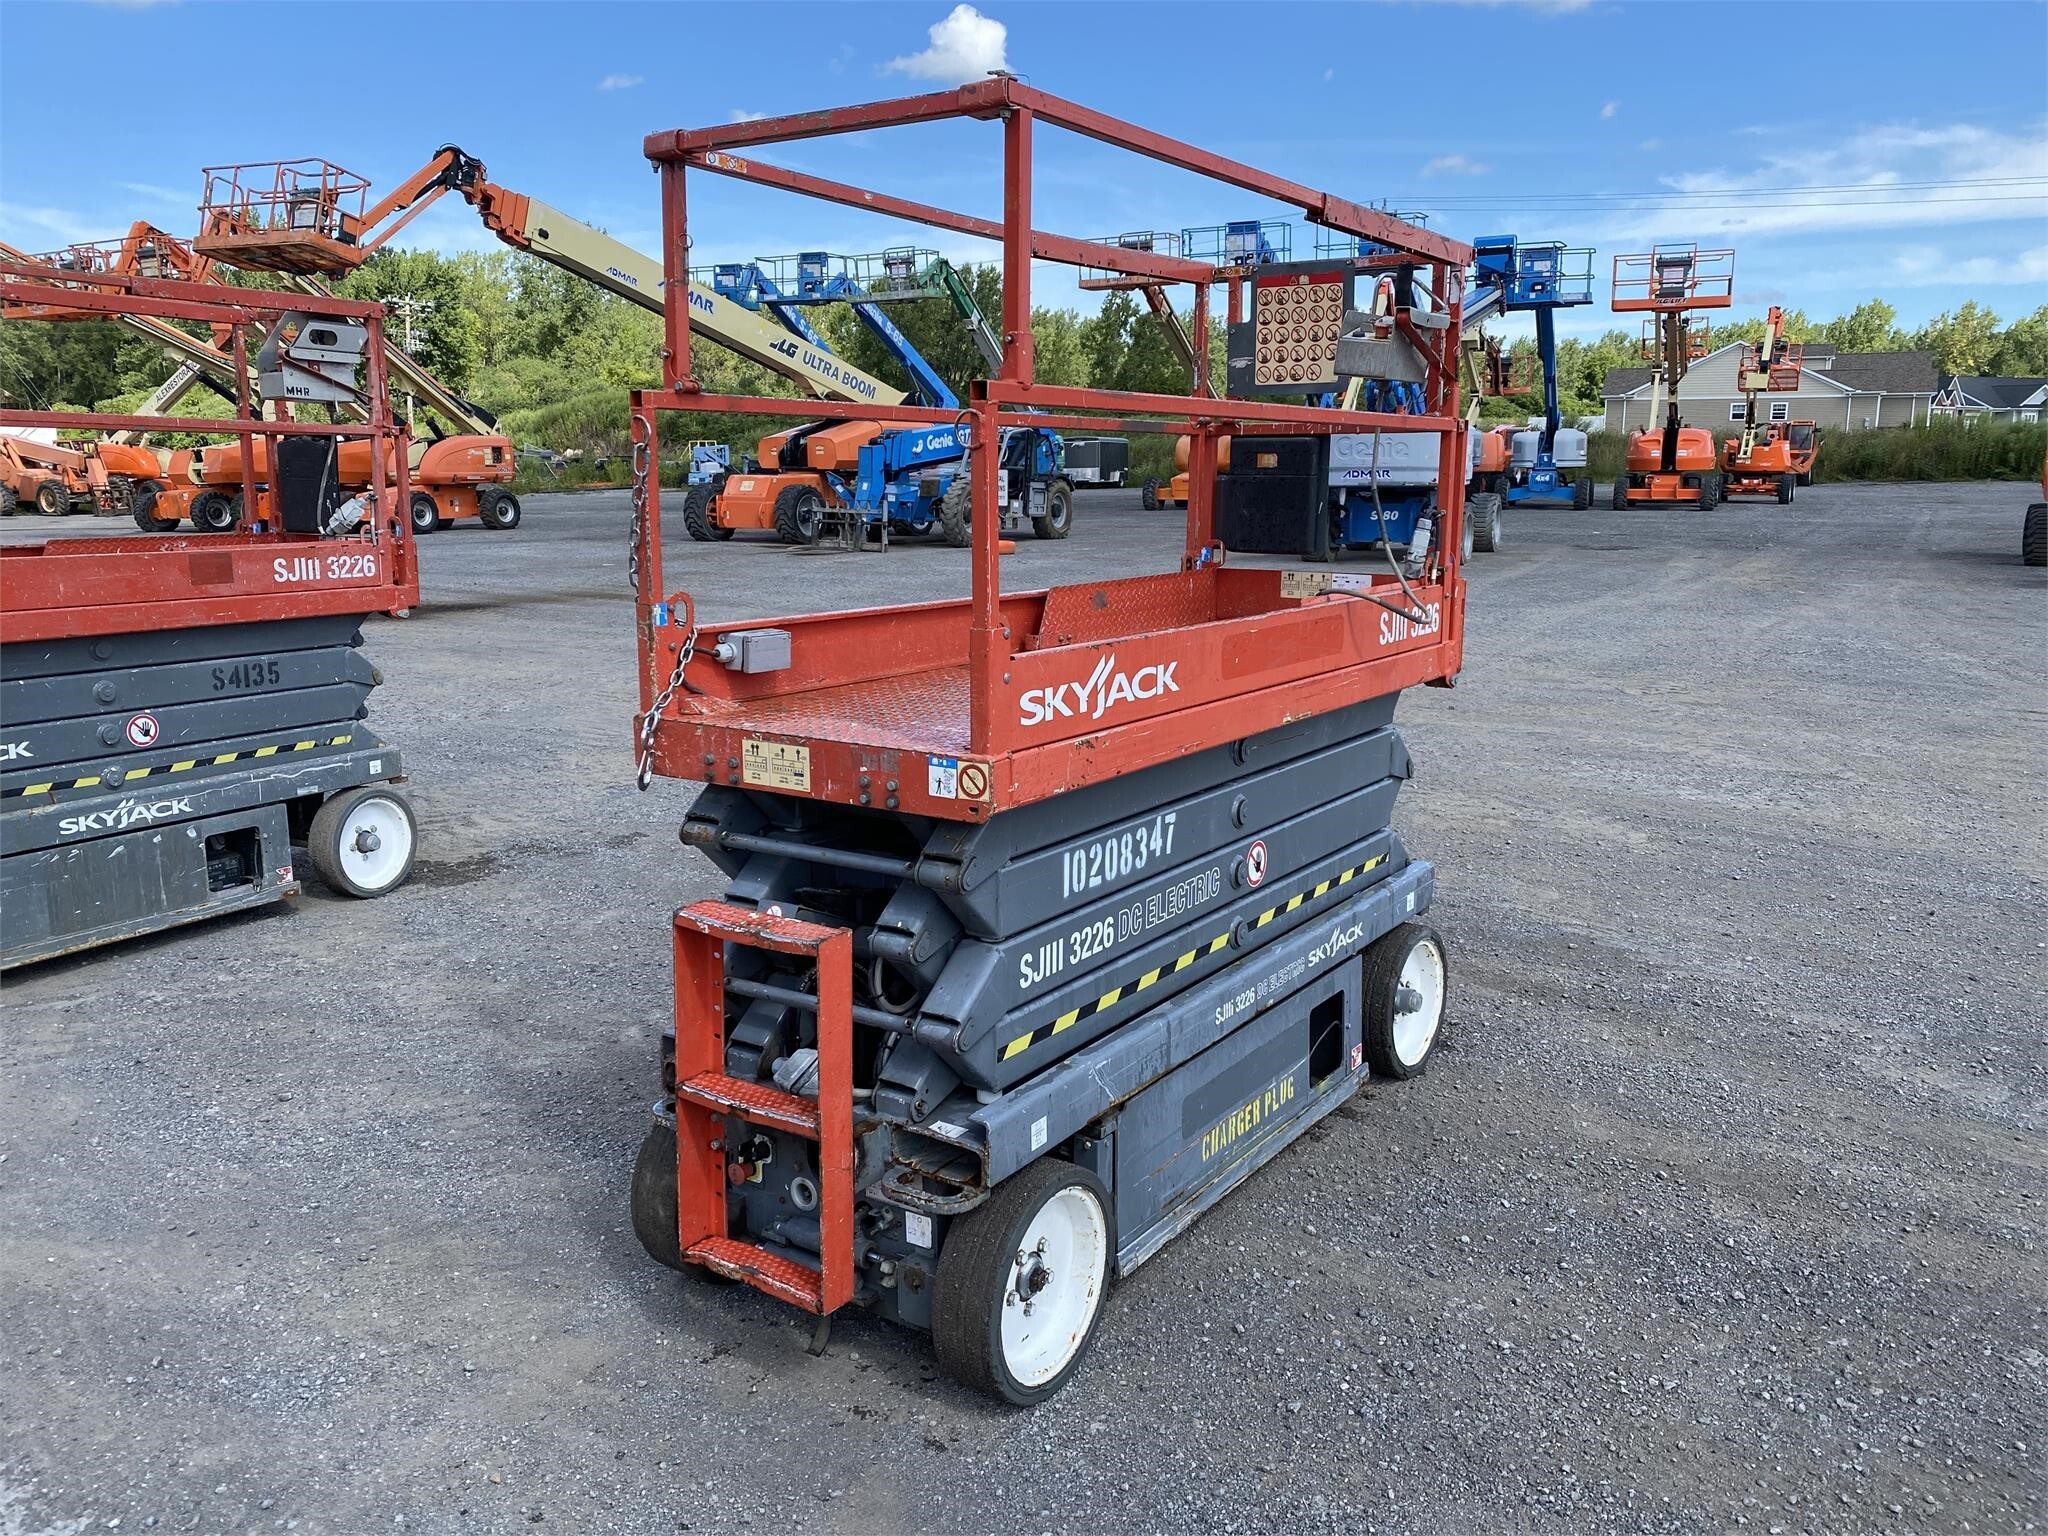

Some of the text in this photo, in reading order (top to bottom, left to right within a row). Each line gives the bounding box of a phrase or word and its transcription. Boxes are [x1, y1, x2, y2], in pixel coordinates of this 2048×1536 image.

[606, 266, 638, 287] ADMAR
[798, 319, 819, 346] S-65
[885, 320, 904, 346] S-65
[769, 339, 877, 399] JLG ULTRA BOOM
[286, 386, 310, 396] MHR
[926, 433, 954, 450] Genie
[1535, 474, 1550, 482] 4x4
[1370, 511, 1399, 520] S80
[273, 554, 376, 583] SJIII 3226
[1411, 602, 1440, 638] 3226
[211, 661, 280, 692] S4135
[1019, 652, 1181, 727] SKYJACK
[58, 798, 194, 835] SKYJACK
[1063, 812, 1177, 899] 10208347
[1019, 867, 1221, 990] SJIII 3226 DC ELECTRIC
[1235, 986, 1256, 1013] 3226
[1256, 978, 1269, 1000] DC
[1268, 956, 1306, 993] ELECTRIC
[1307, 921, 1364, 968] SKYJACK
[1202, 1075, 1295, 1162] CHARGER PLUG
